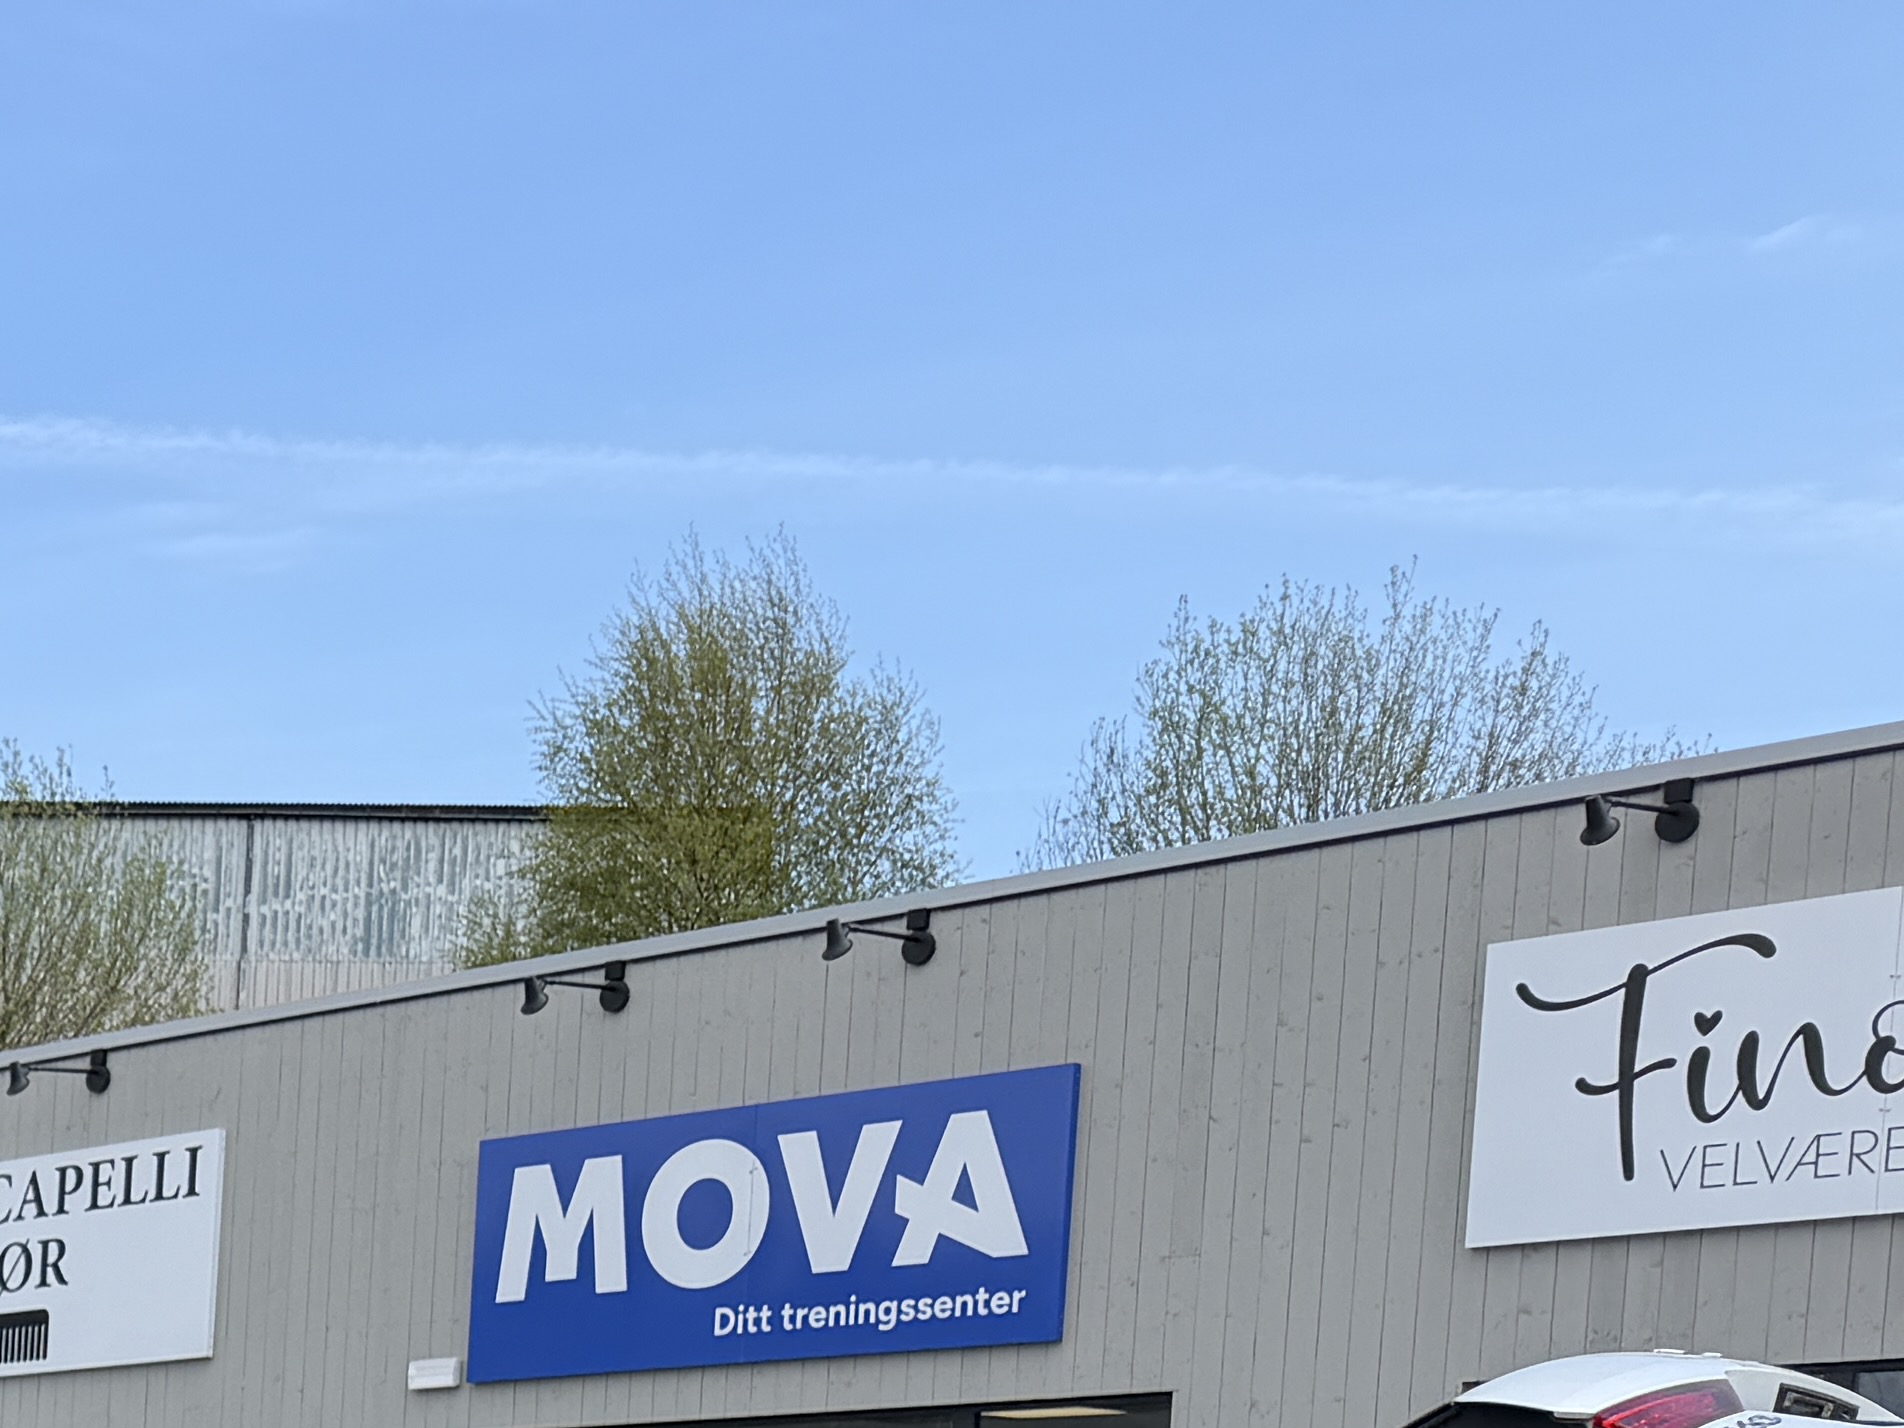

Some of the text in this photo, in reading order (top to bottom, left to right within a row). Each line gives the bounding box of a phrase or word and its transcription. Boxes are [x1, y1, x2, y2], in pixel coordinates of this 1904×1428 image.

[1660, 1126, 1904, 1192] VELVÆRE
[495, 1109, 1029, 1304] MOVA
[713, 1285, 1027, 1337] Ditt treningssenter
